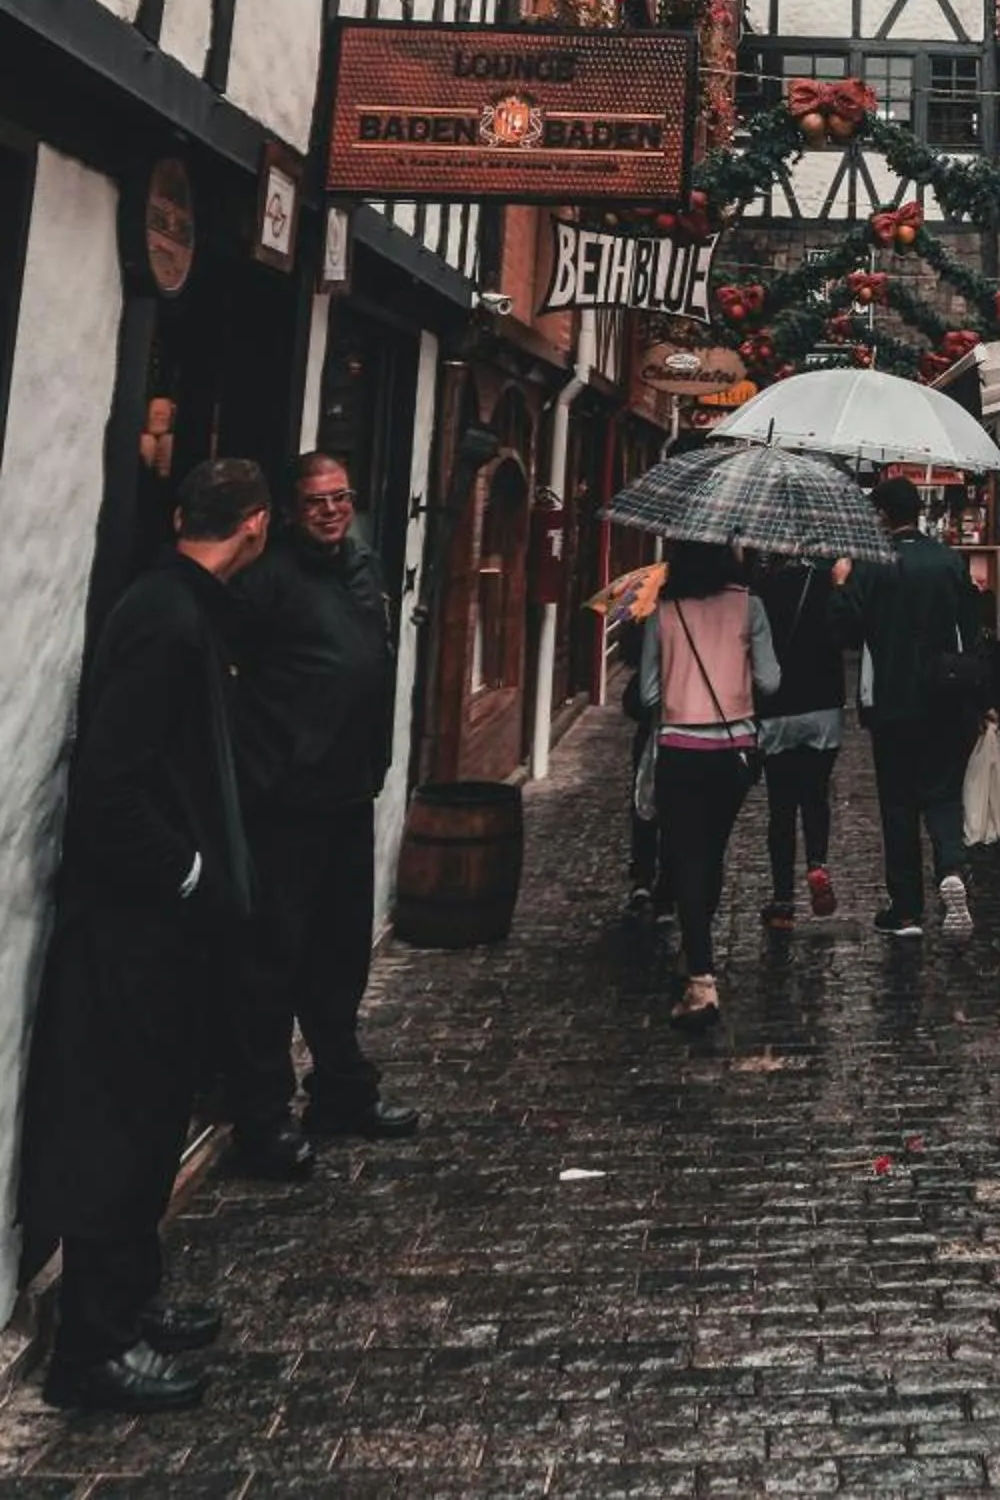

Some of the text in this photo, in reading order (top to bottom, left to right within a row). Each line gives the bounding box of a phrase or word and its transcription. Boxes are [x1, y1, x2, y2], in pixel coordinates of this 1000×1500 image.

[454, 51, 577, 83] LOUNGE
[358, 114, 662, 150] BADEN BADEN
